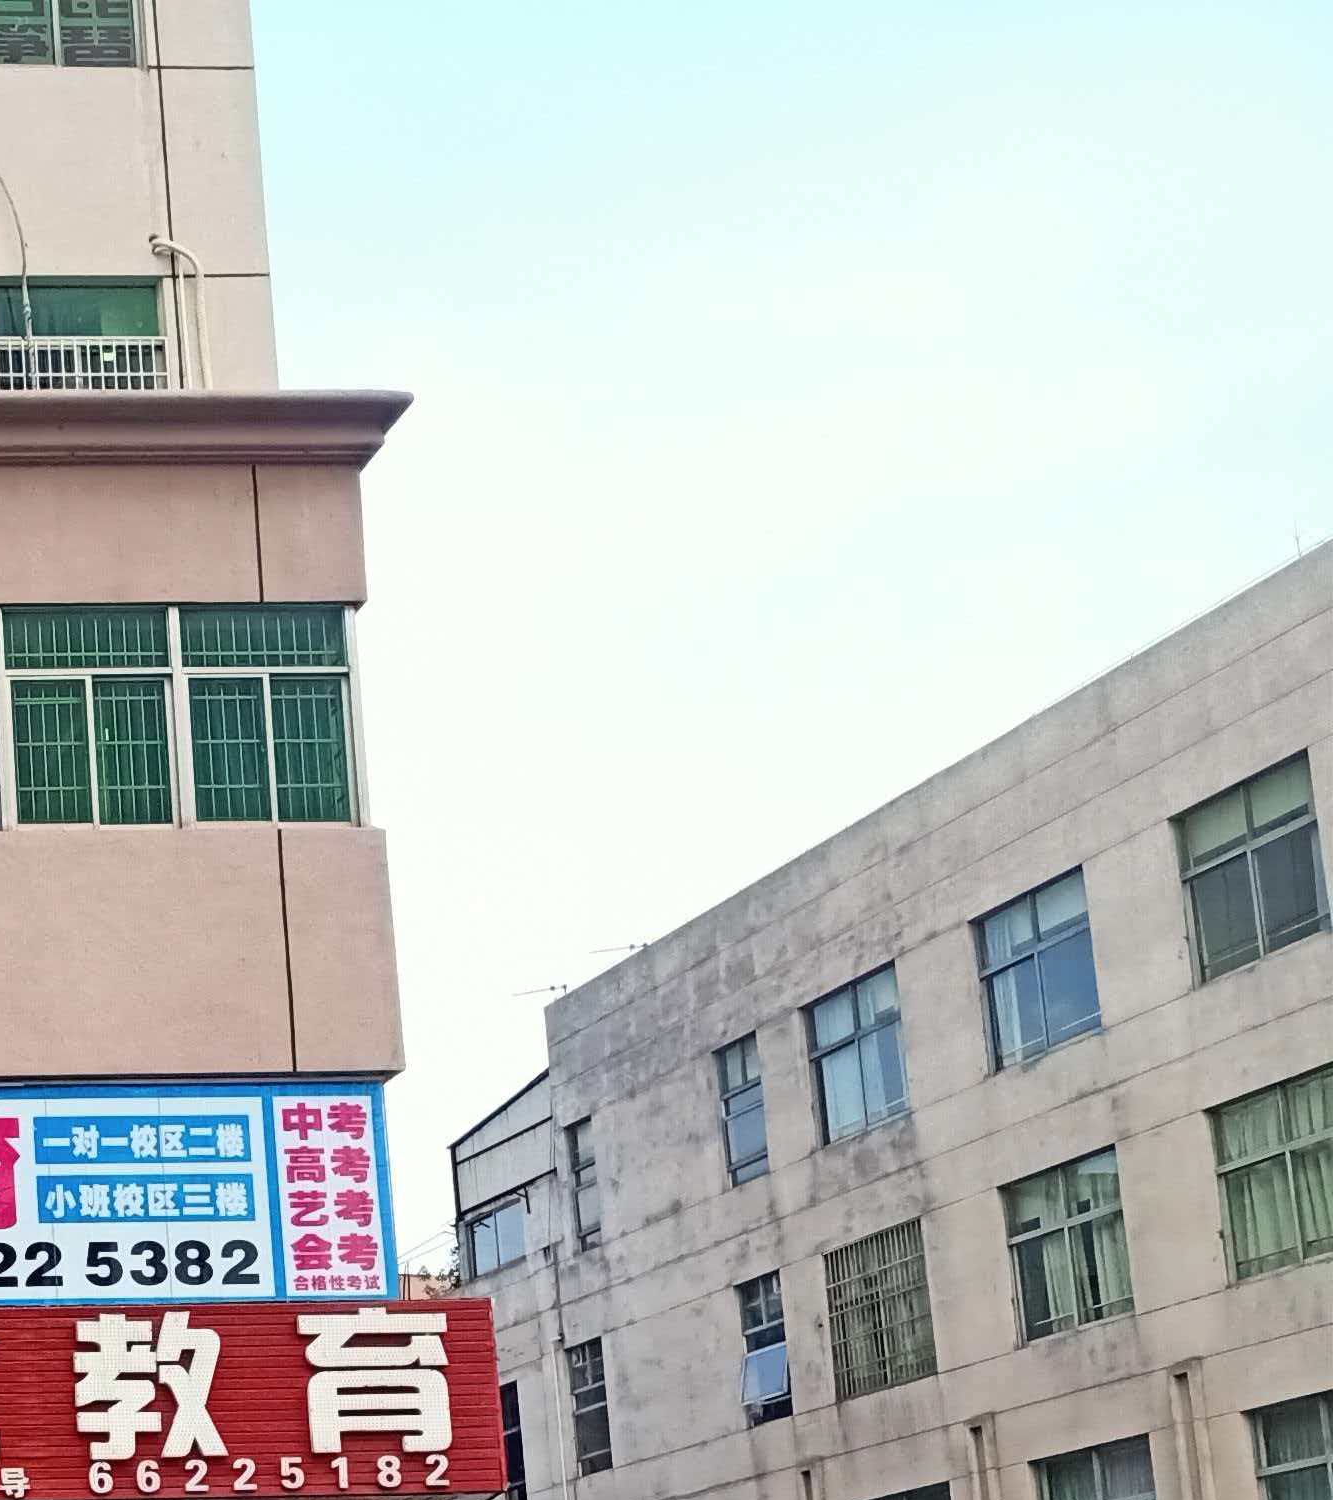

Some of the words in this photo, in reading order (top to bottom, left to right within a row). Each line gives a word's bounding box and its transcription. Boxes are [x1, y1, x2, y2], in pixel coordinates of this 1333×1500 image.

[281, 1102, 365, 1141] 中考
[42, 1122, 246, 1162] 一对一校区二楼
[284, 1145, 371, 1184] 高考
[44, 1178, 248, 1220] 小班校区三楼
[288, 1188, 374, 1228] 艺考
[85, 1238, 260, 1287] 5382
[291, 1232, 379, 1272] 会考
[90, 1454, 451, 1494] 66225182
